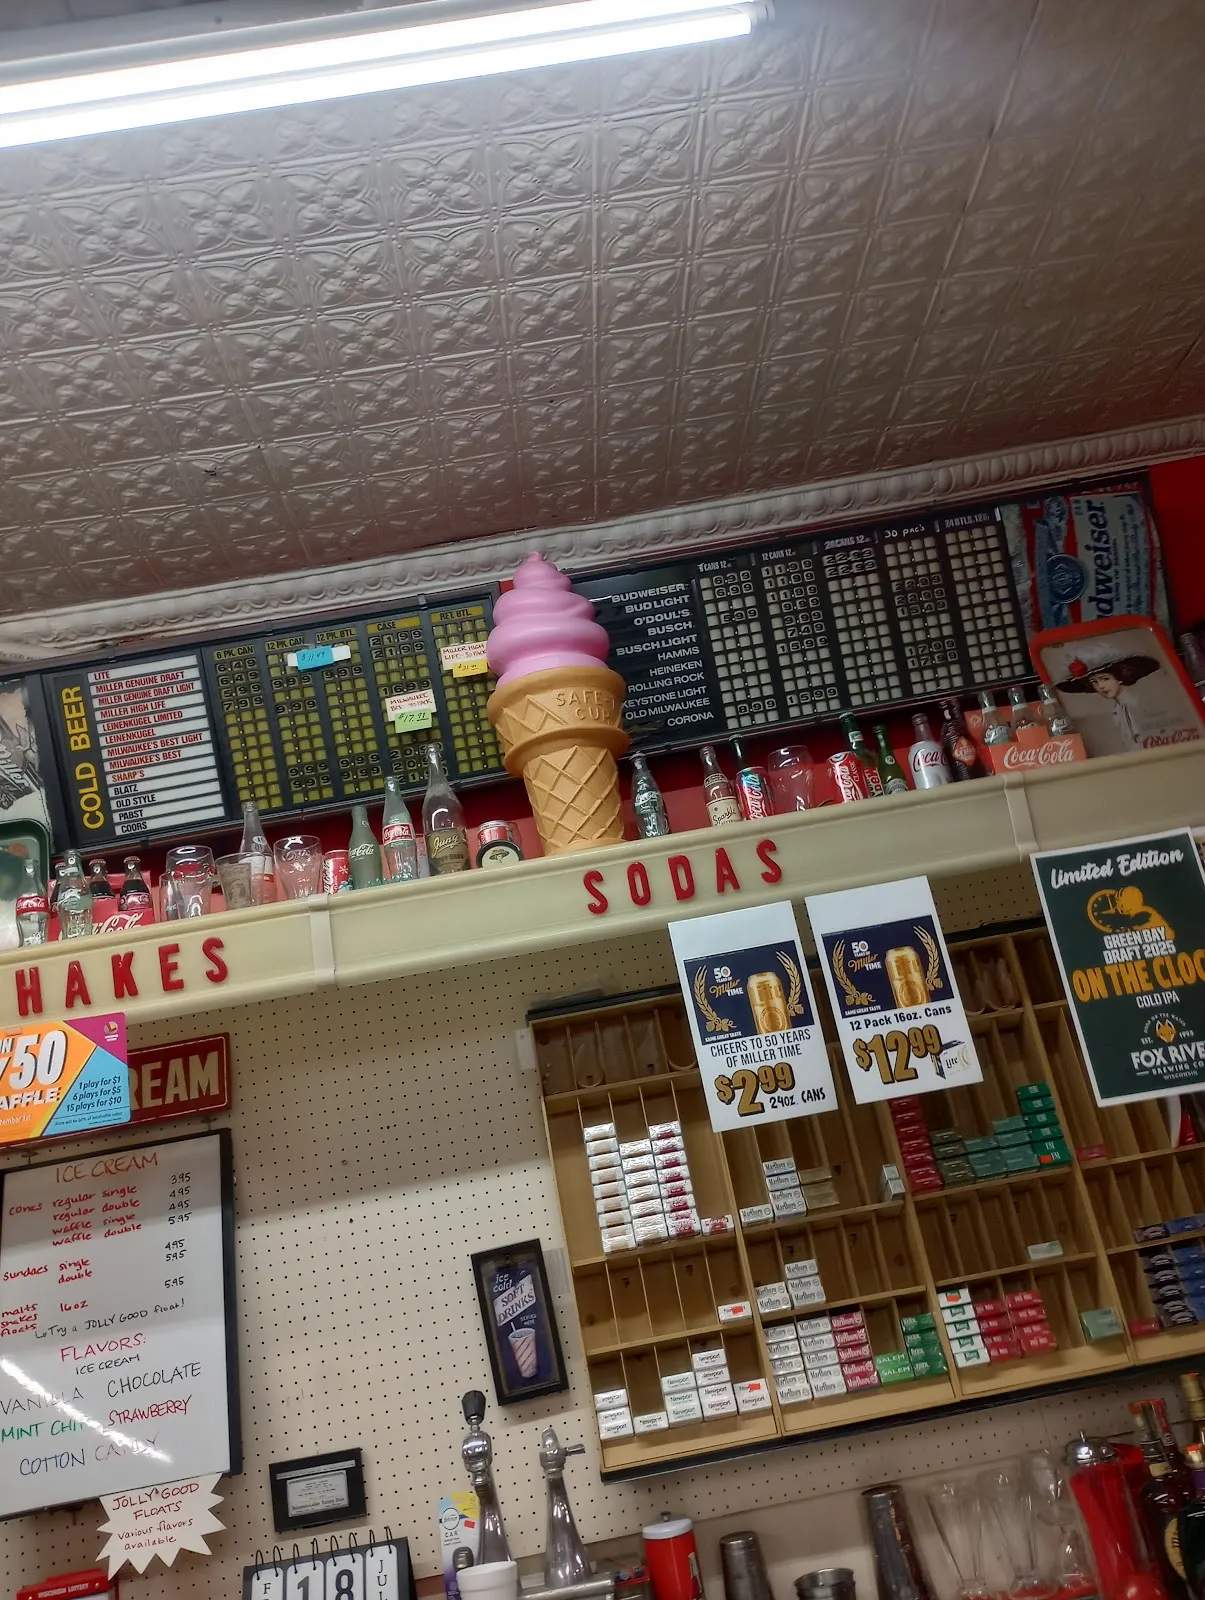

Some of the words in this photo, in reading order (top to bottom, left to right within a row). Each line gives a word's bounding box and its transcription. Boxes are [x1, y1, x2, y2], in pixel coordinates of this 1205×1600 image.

[1085, 500, 1113, 618] dweiser
[611, 583, 686, 603] BUDWEISER
[625, 602, 652, 613] BUD
[654, 594, 690, 609] LIGHT
[633, 609, 691, 625] O'DOUL'S
[647, 621, 693, 636] BUSCH
[616, 641, 660, 656] BUSCH
[661, 634, 697, 648] LIGHT
[658, 646, 700, 661] HAMMS
[94, 671, 110, 680] LITE
[649, 660, 703, 677] HEINEKEN
[96, 681, 124, 693] MILLER
[125, 675, 158, 688] GENUINE
[160, 671, 185, 683] DRAFT
[628, 678, 673, 693] ROLLING
[674, 672, 704, 685] ROCK
[677, 685, 707, 698] LIGHT
[98, 695, 123, 706] MILLER
[124, 689, 152, 702] GENUINE
[154, 685, 174, 696] DRAFT
[176, 682, 195, 693] LIGHT
[100, 707, 128, 719] MILLER
[130, 703, 149, 714] HIGH
[150, 700, 166, 710] LIFE
[625, 709, 647, 720] OLD
[648, 697, 711, 716] MILWAUKEE
[667, 711, 714, 726] CORONA
[61, 686, 91, 752] BEER
[102, 716, 152, 732] LEINENKUGEL
[153, 710, 183, 723] LIMITED
[105, 728, 157, 744] LEINENKUGEL
[107, 740, 159, 757] MILWAUKEE'S
[160, 737, 180, 748] BEST
[181, 732, 204, 744] LIGHT
[109, 753, 161, 770] MILWAUKEE'S
[162, 750, 182, 760] BEST
[111, 769, 145, 783] SHARP'S
[76, 762, 104, 829] COLD
[113, 783, 139, 796] BLATZ
[116, 798, 131, 808] OLD
[132, 794, 157, 806] STYLE
[118, 809, 144, 821] PABST
[121, 821, 148, 834] COORS
[583, 839, 783, 914] SODAS
[1051, 859, 1114, 889] Limited
[1116, 848, 1185, 877] Edition
[851, 940, 868, 954] 50
[1103, 930, 1143, 949] GREEN
[1144, 926, 1166, 942] BAY
[1103, 944, 1144, 965] DRAFT
[1145, 940, 1177, 958] 2025
[714, 966, 731, 980] 50
[864, 961, 882, 971] TIME
[15, 937, 228, 1016] HAKES
[1072, 964, 1108, 1004] ON
[1106, 959, 1154, 997] THE
[727, 987, 744, 996] TIME
[1136, 993, 1162, 1008] COLD
[1162, 990, 1181, 1004] IPA
[849, 1020, 862, 1031] 12
[864, 1013, 892, 1029] Pack
[894, 1011, 922, 1024] 16oz.
[925, 1005, 952, 1018] Cans
[710, 1042, 748, 1058] CHEERS
[750, 1038, 763, 1050] TO
[765, 1034, 778, 1046] 50
[780, 1028, 811, 1044] YEARS
[726, 1056, 738, 1068] OF
[741, 1050, 776, 1066] MILLER
[778, 1044, 802, 1059] TIME
[1131, 1047, 1168, 1070] FOX
[73, 1092, 78, 1100] 6
[79, 1089, 98, 1101] plays
[100, 1088, 110, 1096] for
[112, 1086, 121, 1096] $5
[83, 1080, 100, 1092] play
[101, 1078, 111, 1086] for
[112, 1076, 121, 1085] $1
[66, 1104, 74, 1112] 15
[75, 1101, 95, 1112] plays
[96, 1100, 108, 1108] for
[109, 1096, 122, 1106] $10
[801, 1087, 826, 1103] CANS
[56, 1164, 86, 1184] ICE
[91, 1152, 160, 1178] CREAM
[9, 1203, 43, 1216] cones
[52, 1194, 96, 1210] regular
[102, 1186, 138, 1201] single
[52, 1207, 96, 1222] regular
[102, 1199, 141, 1214] double
[52, 1219, 93, 1236] waffle
[103, 1213, 136, 1226] single
[52, 1231, 92, 1247] waffle
[104, 1223, 144, 1239] double
[59, 1258, 92, 1272] single
[58, 1269, 94, 1284] double
[492, 1280, 513, 1293] cold
[495, 1273, 510, 1284] ice
[502, 1284, 525, 1308] SOFT
[2, 1303, 39, 1318] malts
[498, 1292, 535, 1322] DRINKS
[48, 1325, 68, 1337] Try
[85, 1314, 116, 1330] JOLLY
[120, 1310, 148, 1322] GOOD
[75, 1363, 96, 1375] ICE
[98, 1354, 140, 1370] CREAM
[876, 1354, 906, 1364] SALEM
[107, 1362, 202, 1398] CHOCOLATE
[881, 1366, 911, 1376] SALEM
[1, 1422, 46, 1442] MINT
[107, 1395, 192, 1427] STRAWBERRY
[19, 1449, 86, 1476] COTTON
[112, 1487, 155, 1511] JOLLY
[161, 1482, 200, 1500] GOOD
[133, 1500, 183, 1520] FLOATS
[118, 1526, 152, 1540] various
[156, 1518, 194, 1534] flavors
[124, 1534, 177, 1551] available
